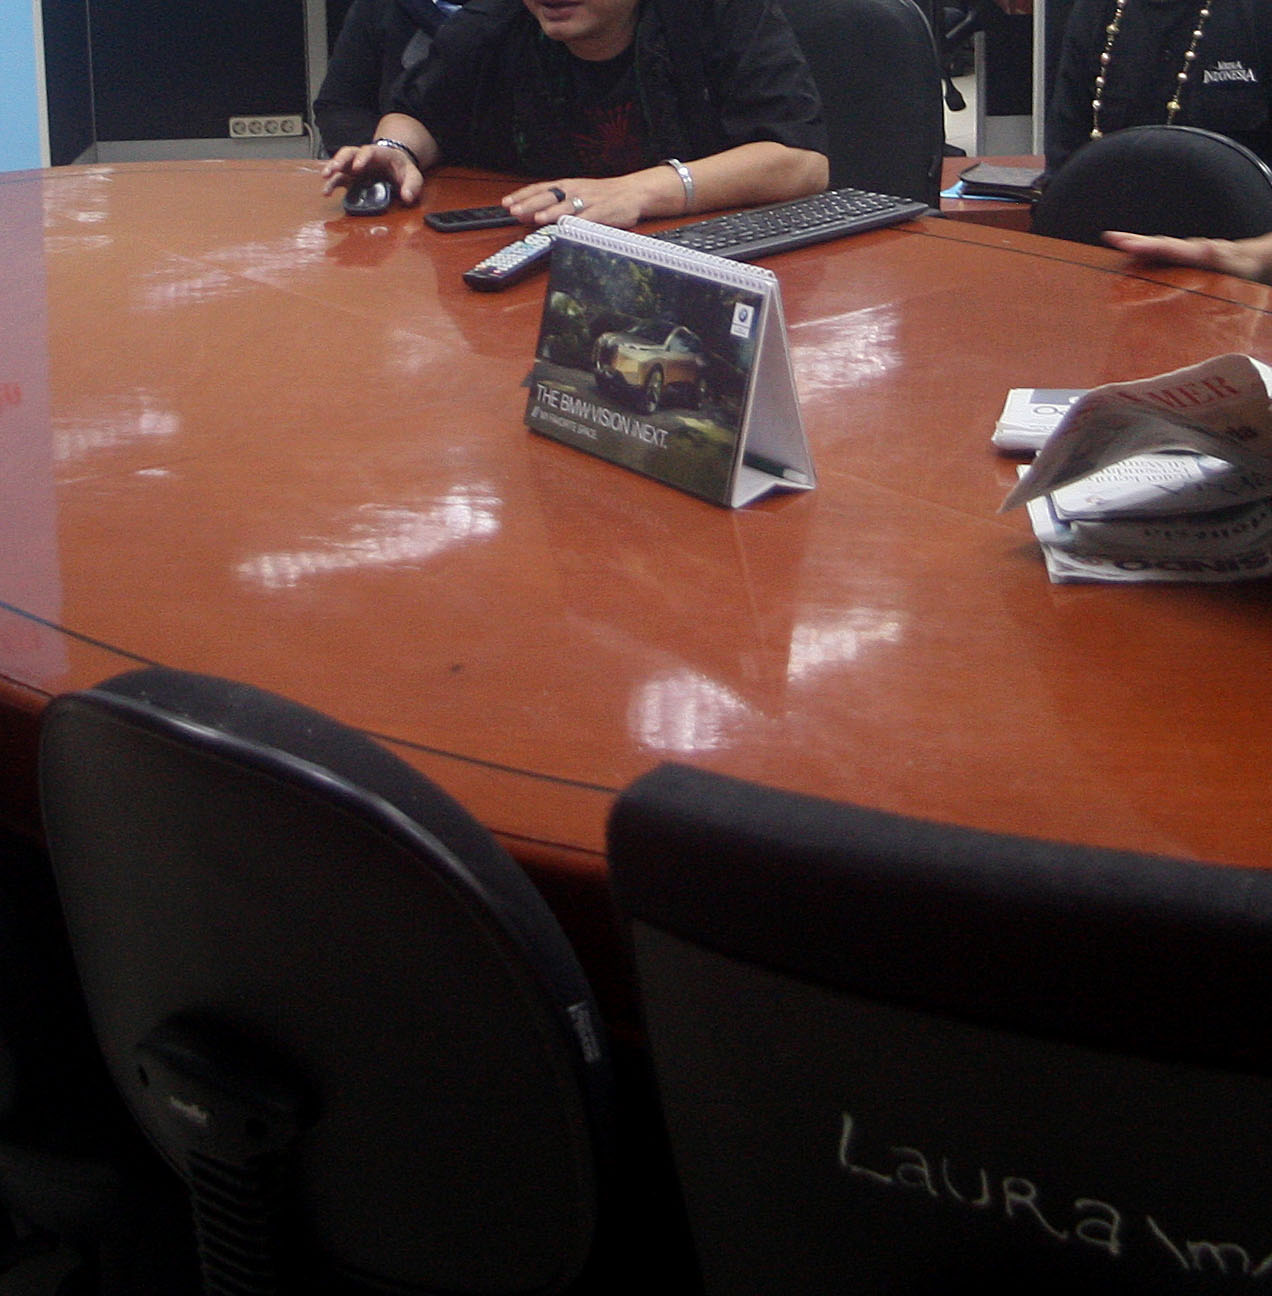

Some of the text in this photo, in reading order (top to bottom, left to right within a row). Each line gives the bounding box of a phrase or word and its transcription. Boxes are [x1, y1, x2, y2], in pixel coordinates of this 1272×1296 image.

[536, 384, 560, 409] THE
[560, 392, 588, 420] BMW
[589, 402, 631, 435] VISION
